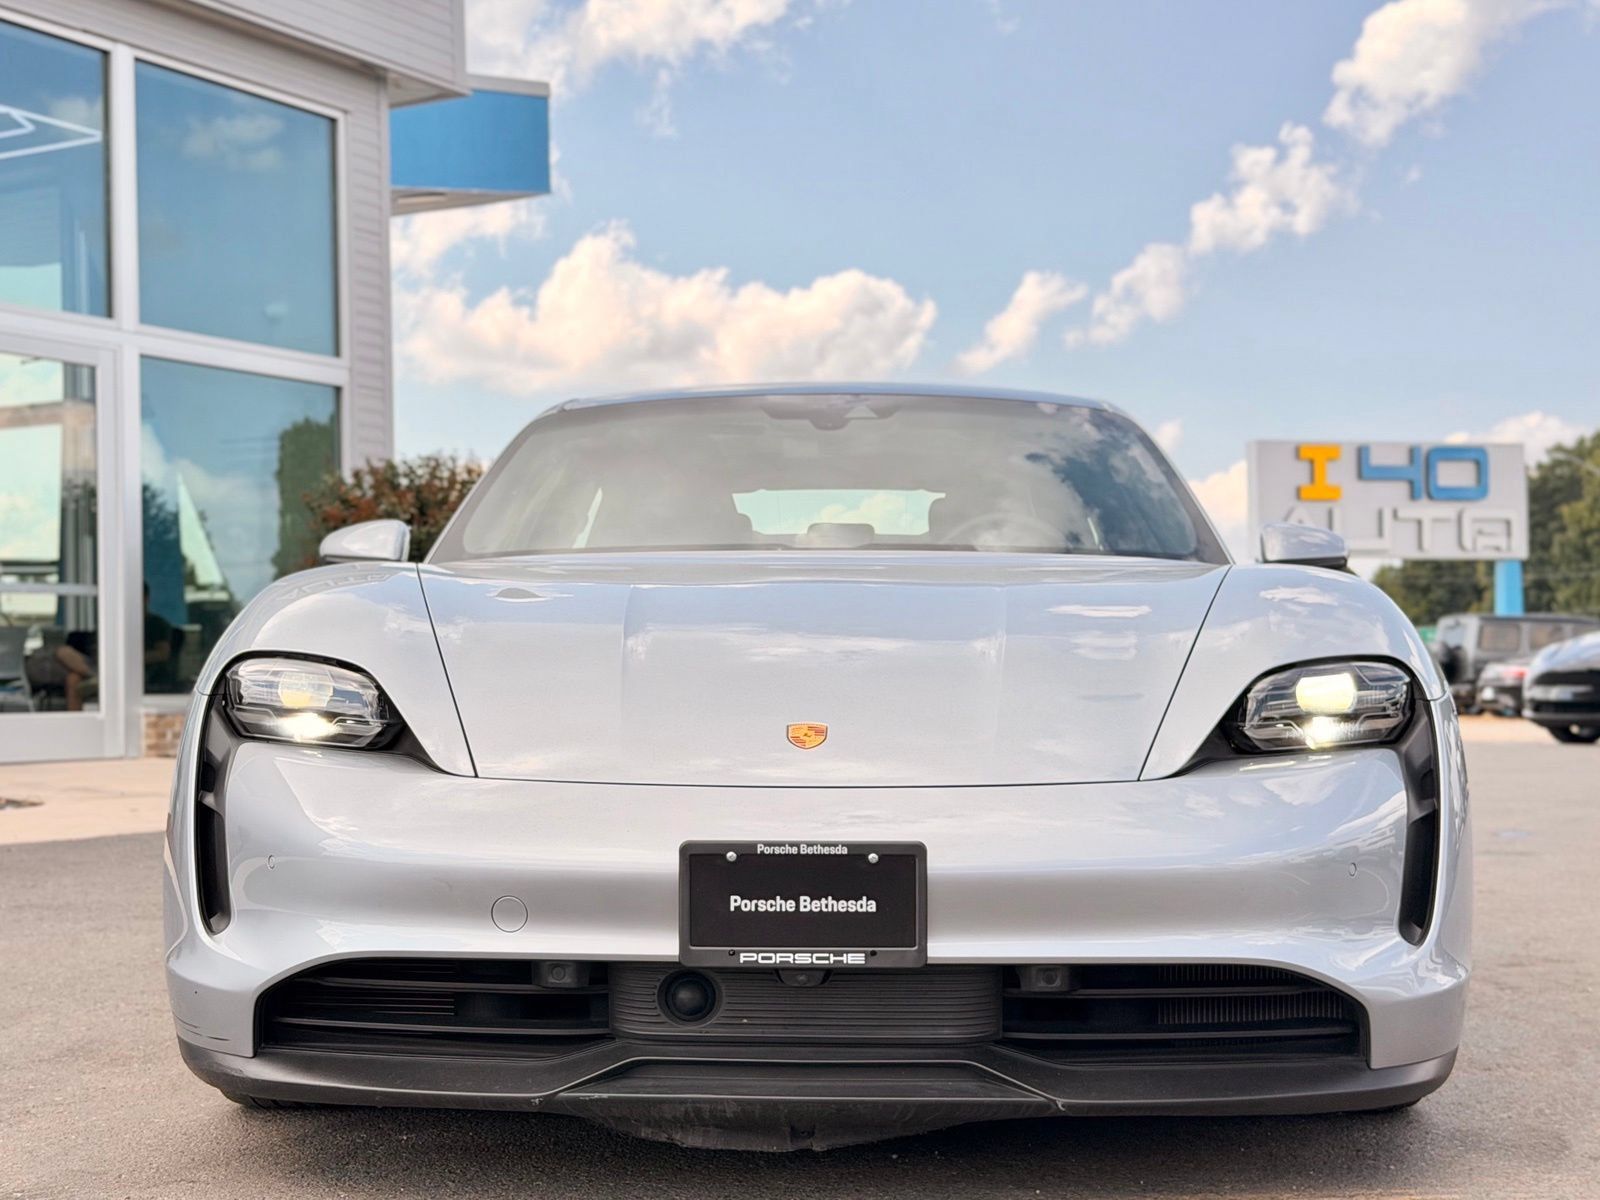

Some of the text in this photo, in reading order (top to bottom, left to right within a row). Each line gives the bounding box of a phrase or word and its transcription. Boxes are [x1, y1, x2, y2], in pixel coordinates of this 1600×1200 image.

[1297, 443, 1488, 501] I 40
[757, 843, 848, 856] Porsche Bethesda
[730, 895, 877, 913] Porsche Bethesda
[739, 952, 866, 965] PORSCHE
